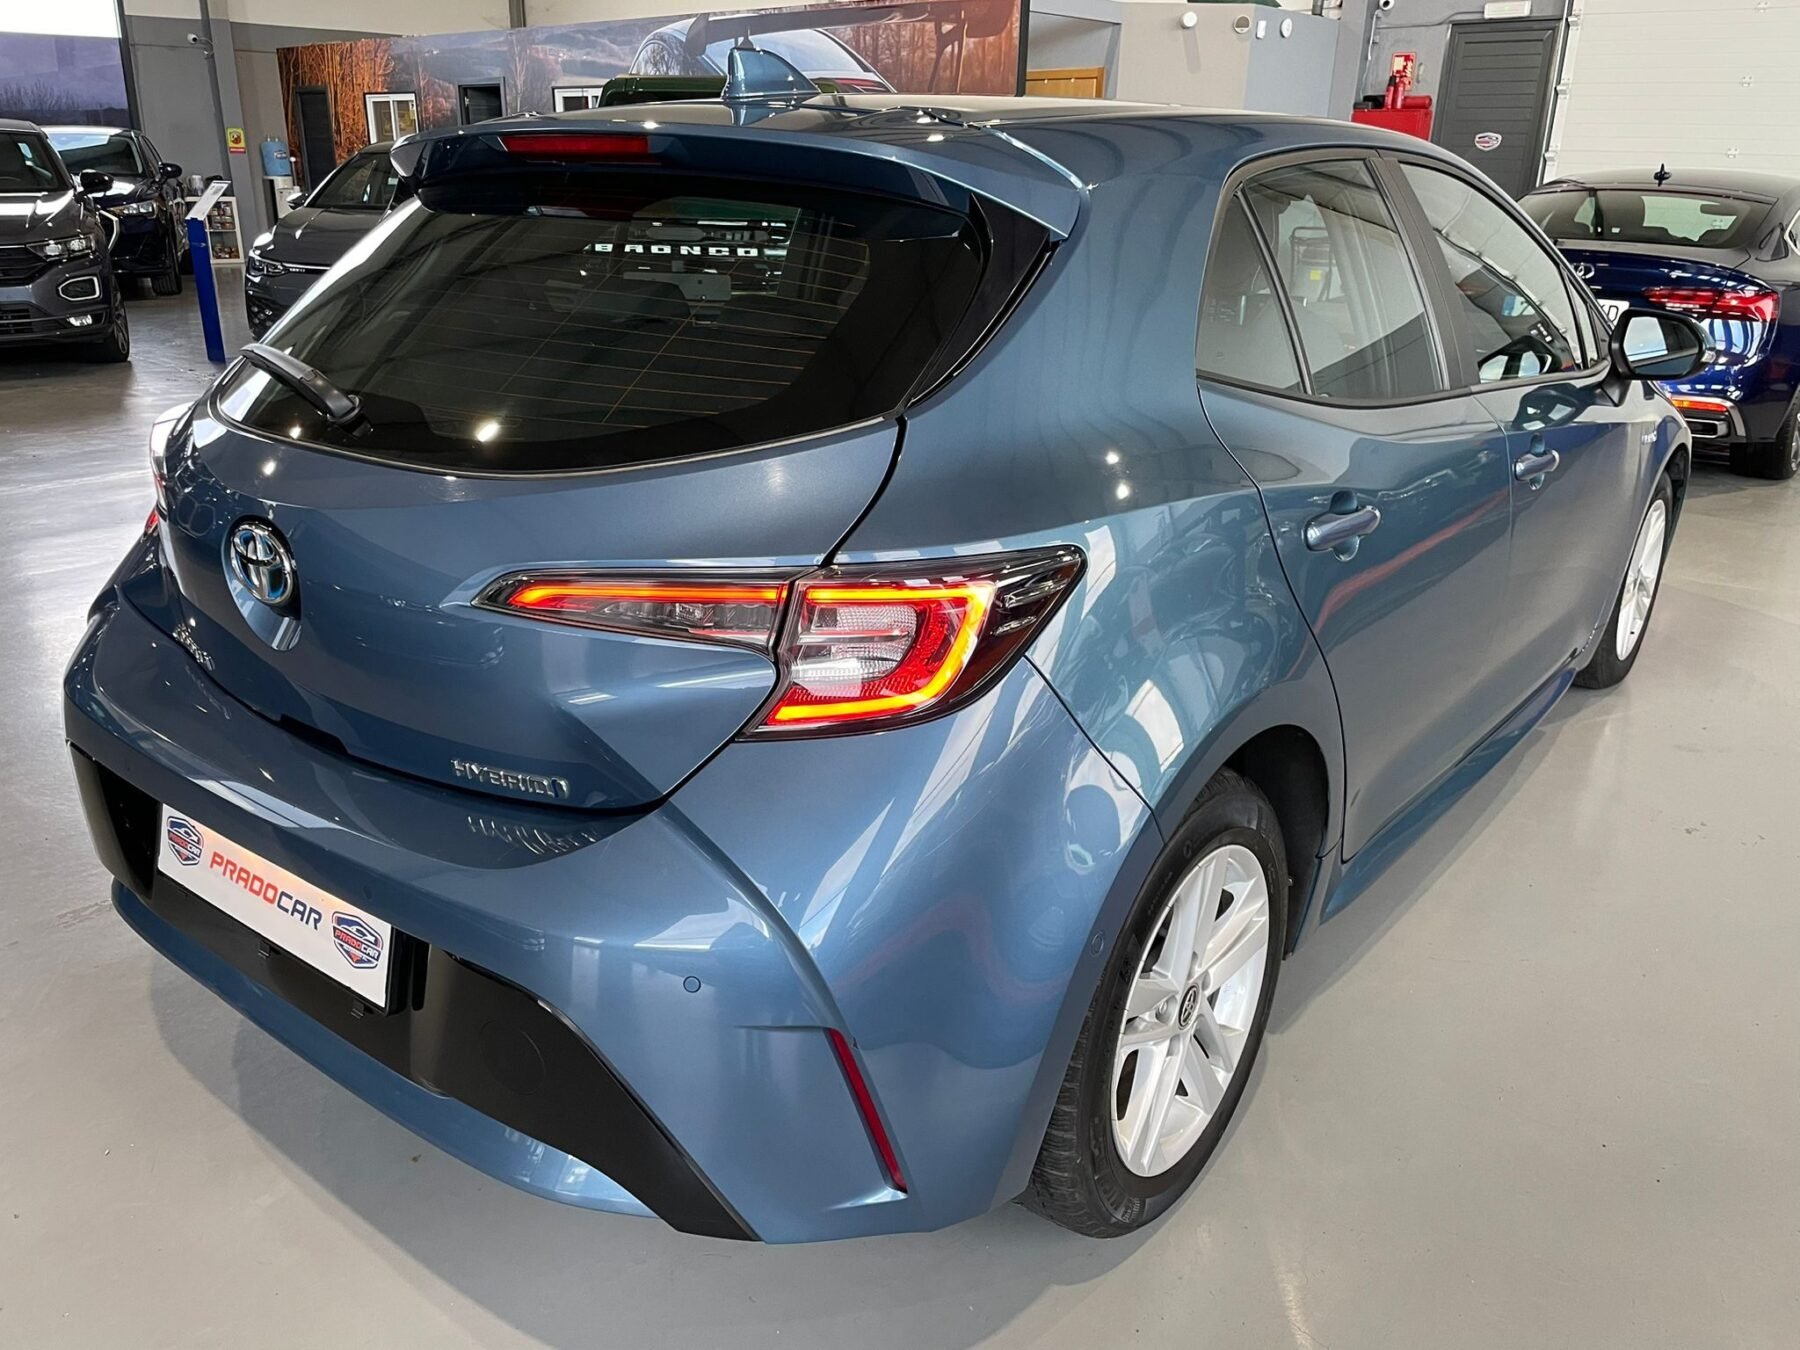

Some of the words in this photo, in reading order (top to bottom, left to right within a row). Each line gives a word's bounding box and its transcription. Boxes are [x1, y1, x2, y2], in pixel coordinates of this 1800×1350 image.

[594, 243, 758, 257] BRONCO
[451, 759, 556, 798] HYBRID
[209, 851, 322, 930] PRADOCAR
[334, 929, 380, 960] PRADOCAR
